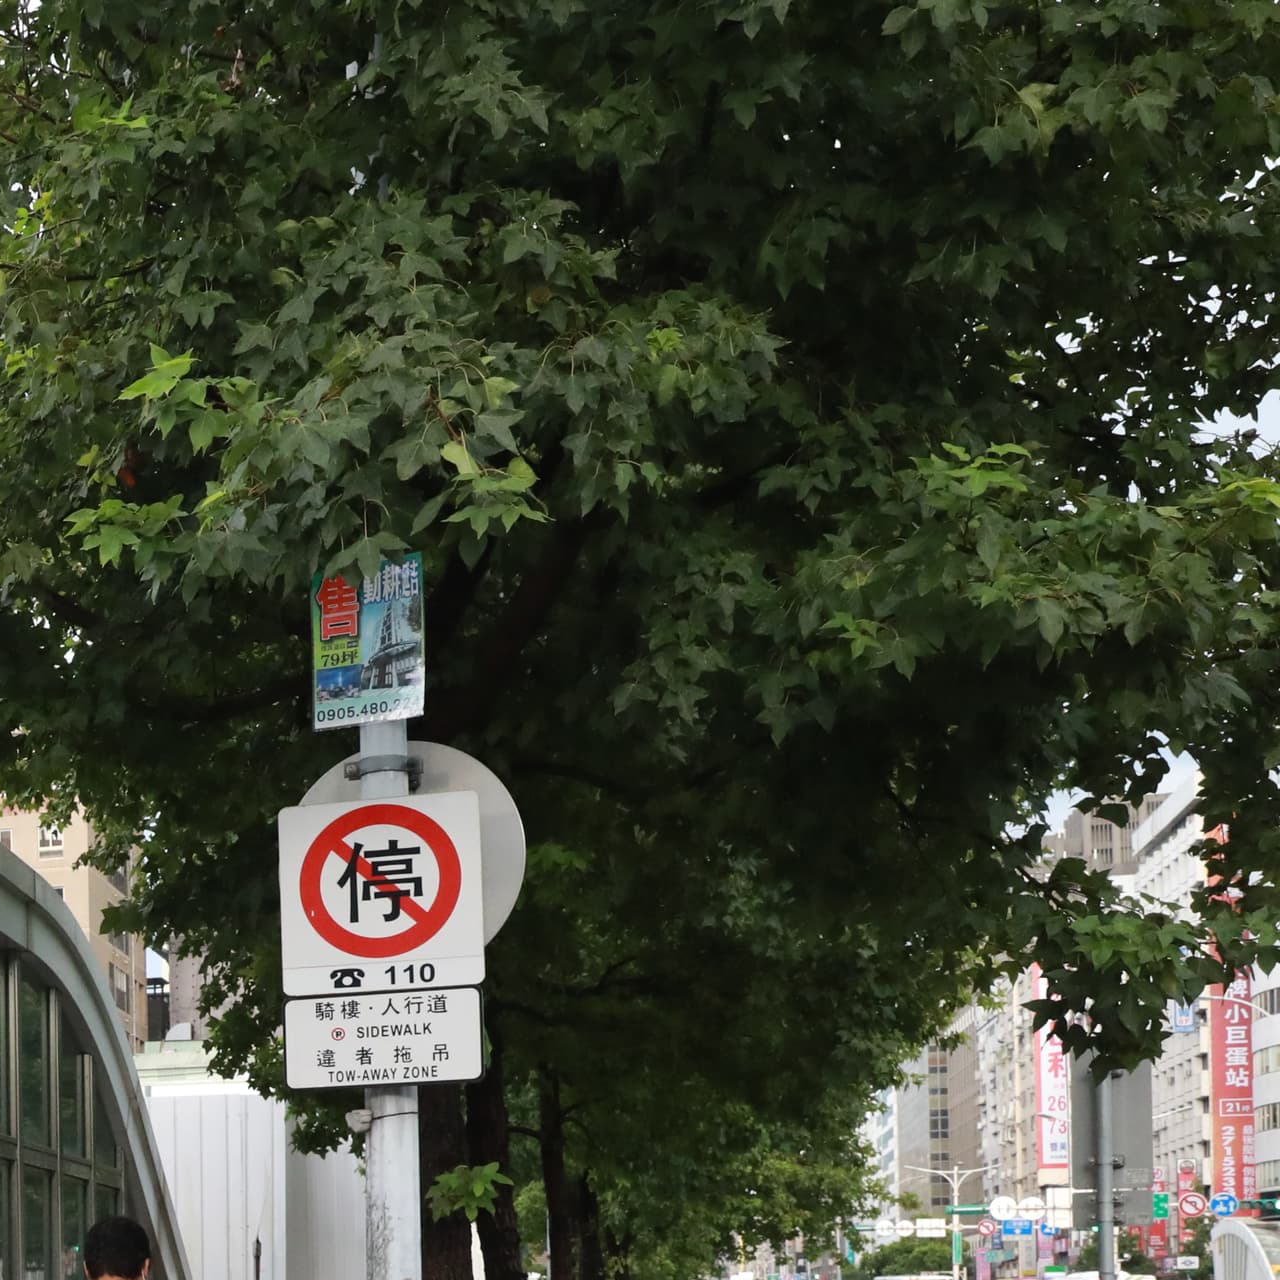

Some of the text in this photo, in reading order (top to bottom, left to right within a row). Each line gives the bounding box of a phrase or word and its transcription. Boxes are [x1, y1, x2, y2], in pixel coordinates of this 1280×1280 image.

[316, 574, 360, 641] 售
[337, 839, 424, 923] 停
[384, 963, 436, 985] 110
[356, 1023, 432, 1039] SIDEWALK
[317, 1043, 450, 1068] 違者拖吊
[328, 1065, 438, 1083] TOW-AWAY ZONE
